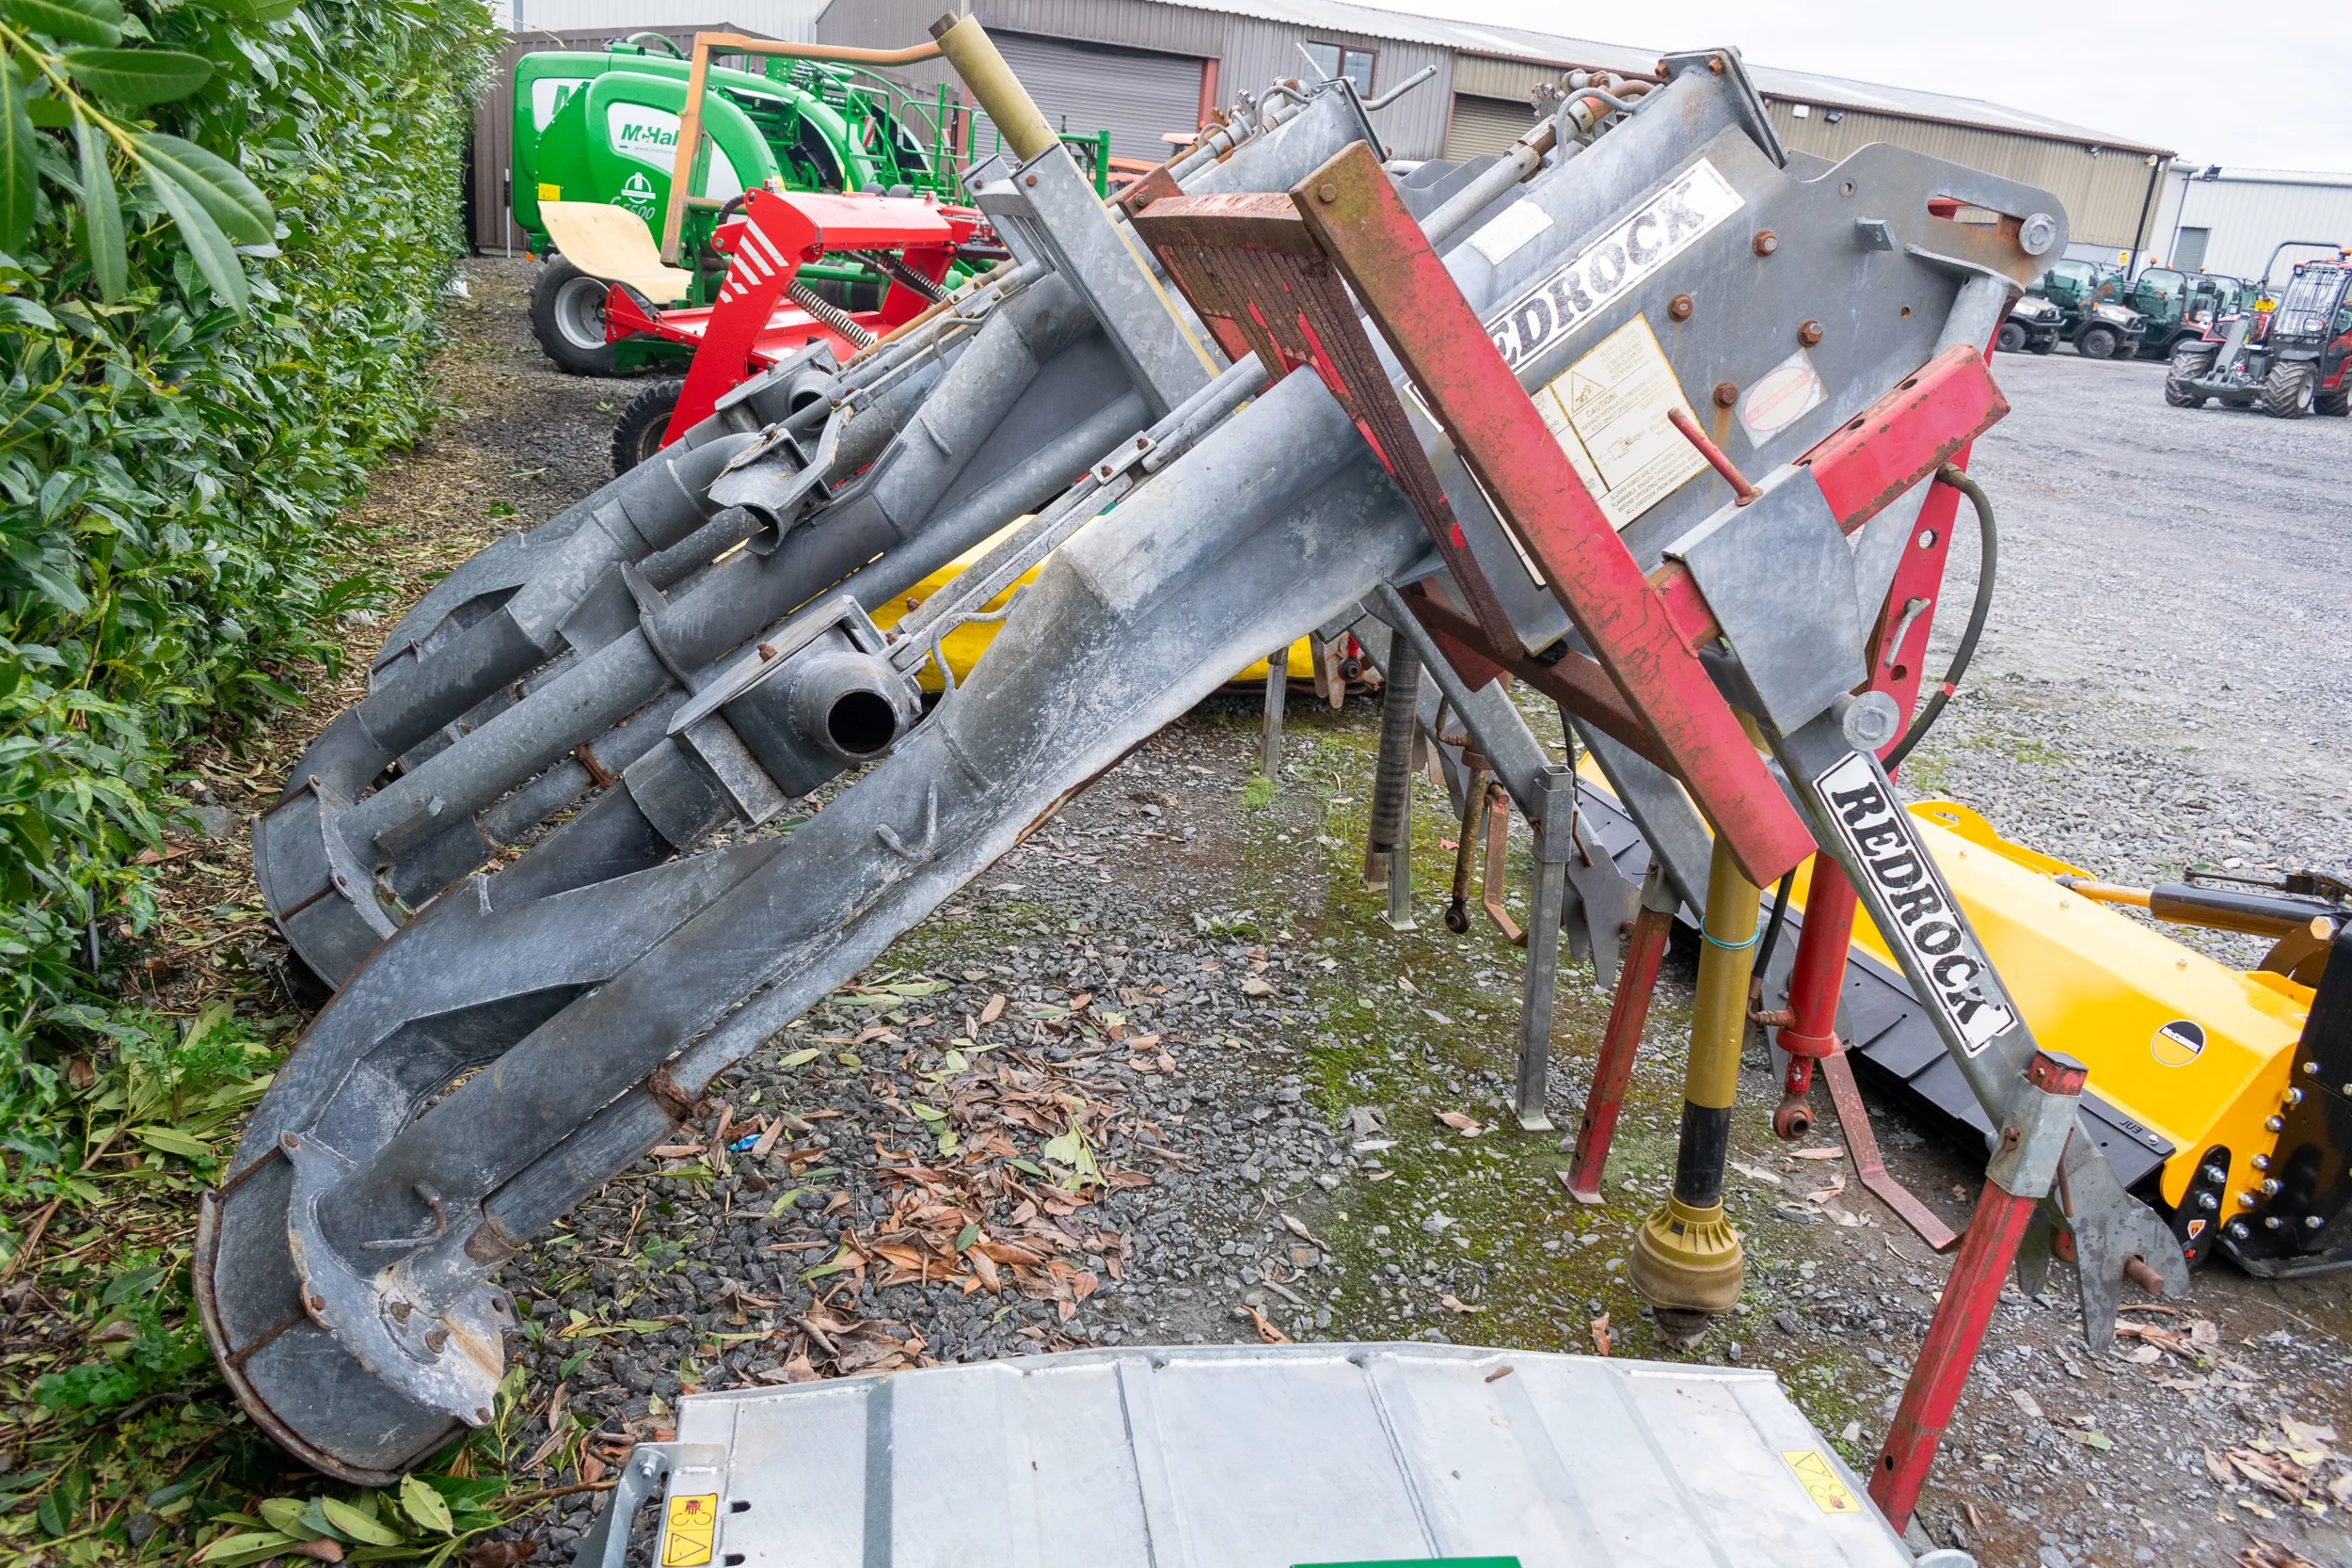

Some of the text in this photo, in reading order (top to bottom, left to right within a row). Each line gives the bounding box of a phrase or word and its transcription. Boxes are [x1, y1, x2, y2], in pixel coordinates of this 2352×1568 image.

[621, 123, 680, 146] McHal
[1490, 179, 1706, 366] EDROCK
[1583, 390, 1619, 419] CAUTION!
[1616, 497, 1635, 513] BEFORE
[1633, 480, 1659, 500] OPERATING
[1657, 473, 1667, 483] THIS
[1624, 505, 1634, 515] ALL
[1632, 489, 1657, 509] LIVESTOCK
[1655, 480, 1670, 493] FROM
[1831, 781, 2002, 1025] REDROCK
